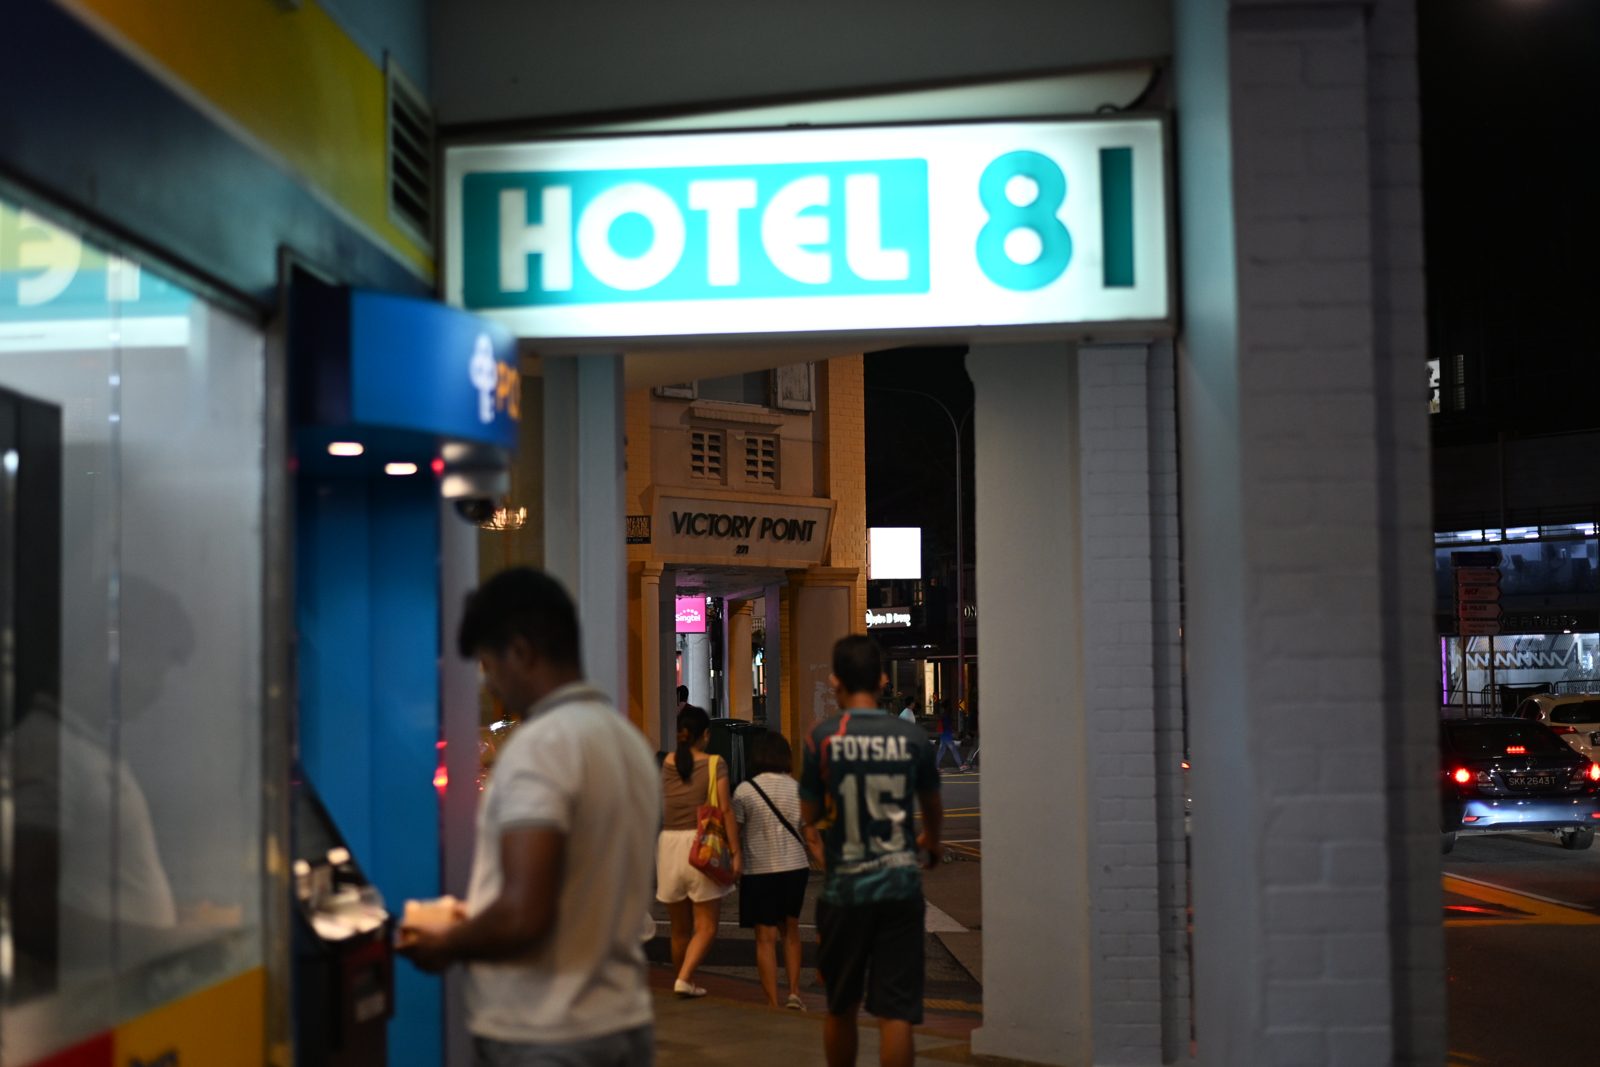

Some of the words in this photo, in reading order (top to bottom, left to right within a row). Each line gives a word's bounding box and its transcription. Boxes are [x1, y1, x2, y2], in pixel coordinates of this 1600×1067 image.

[499, 173, 910, 293] HOTEL
[976, 146, 1136, 291] 81
[672, 511, 756, 538] VICTORY
[760, 517, 816, 542] POINT
[675, 613, 701, 624] Singtel
[829, 734, 912, 761] FOYSAL
[838, 773, 907, 860] 15
